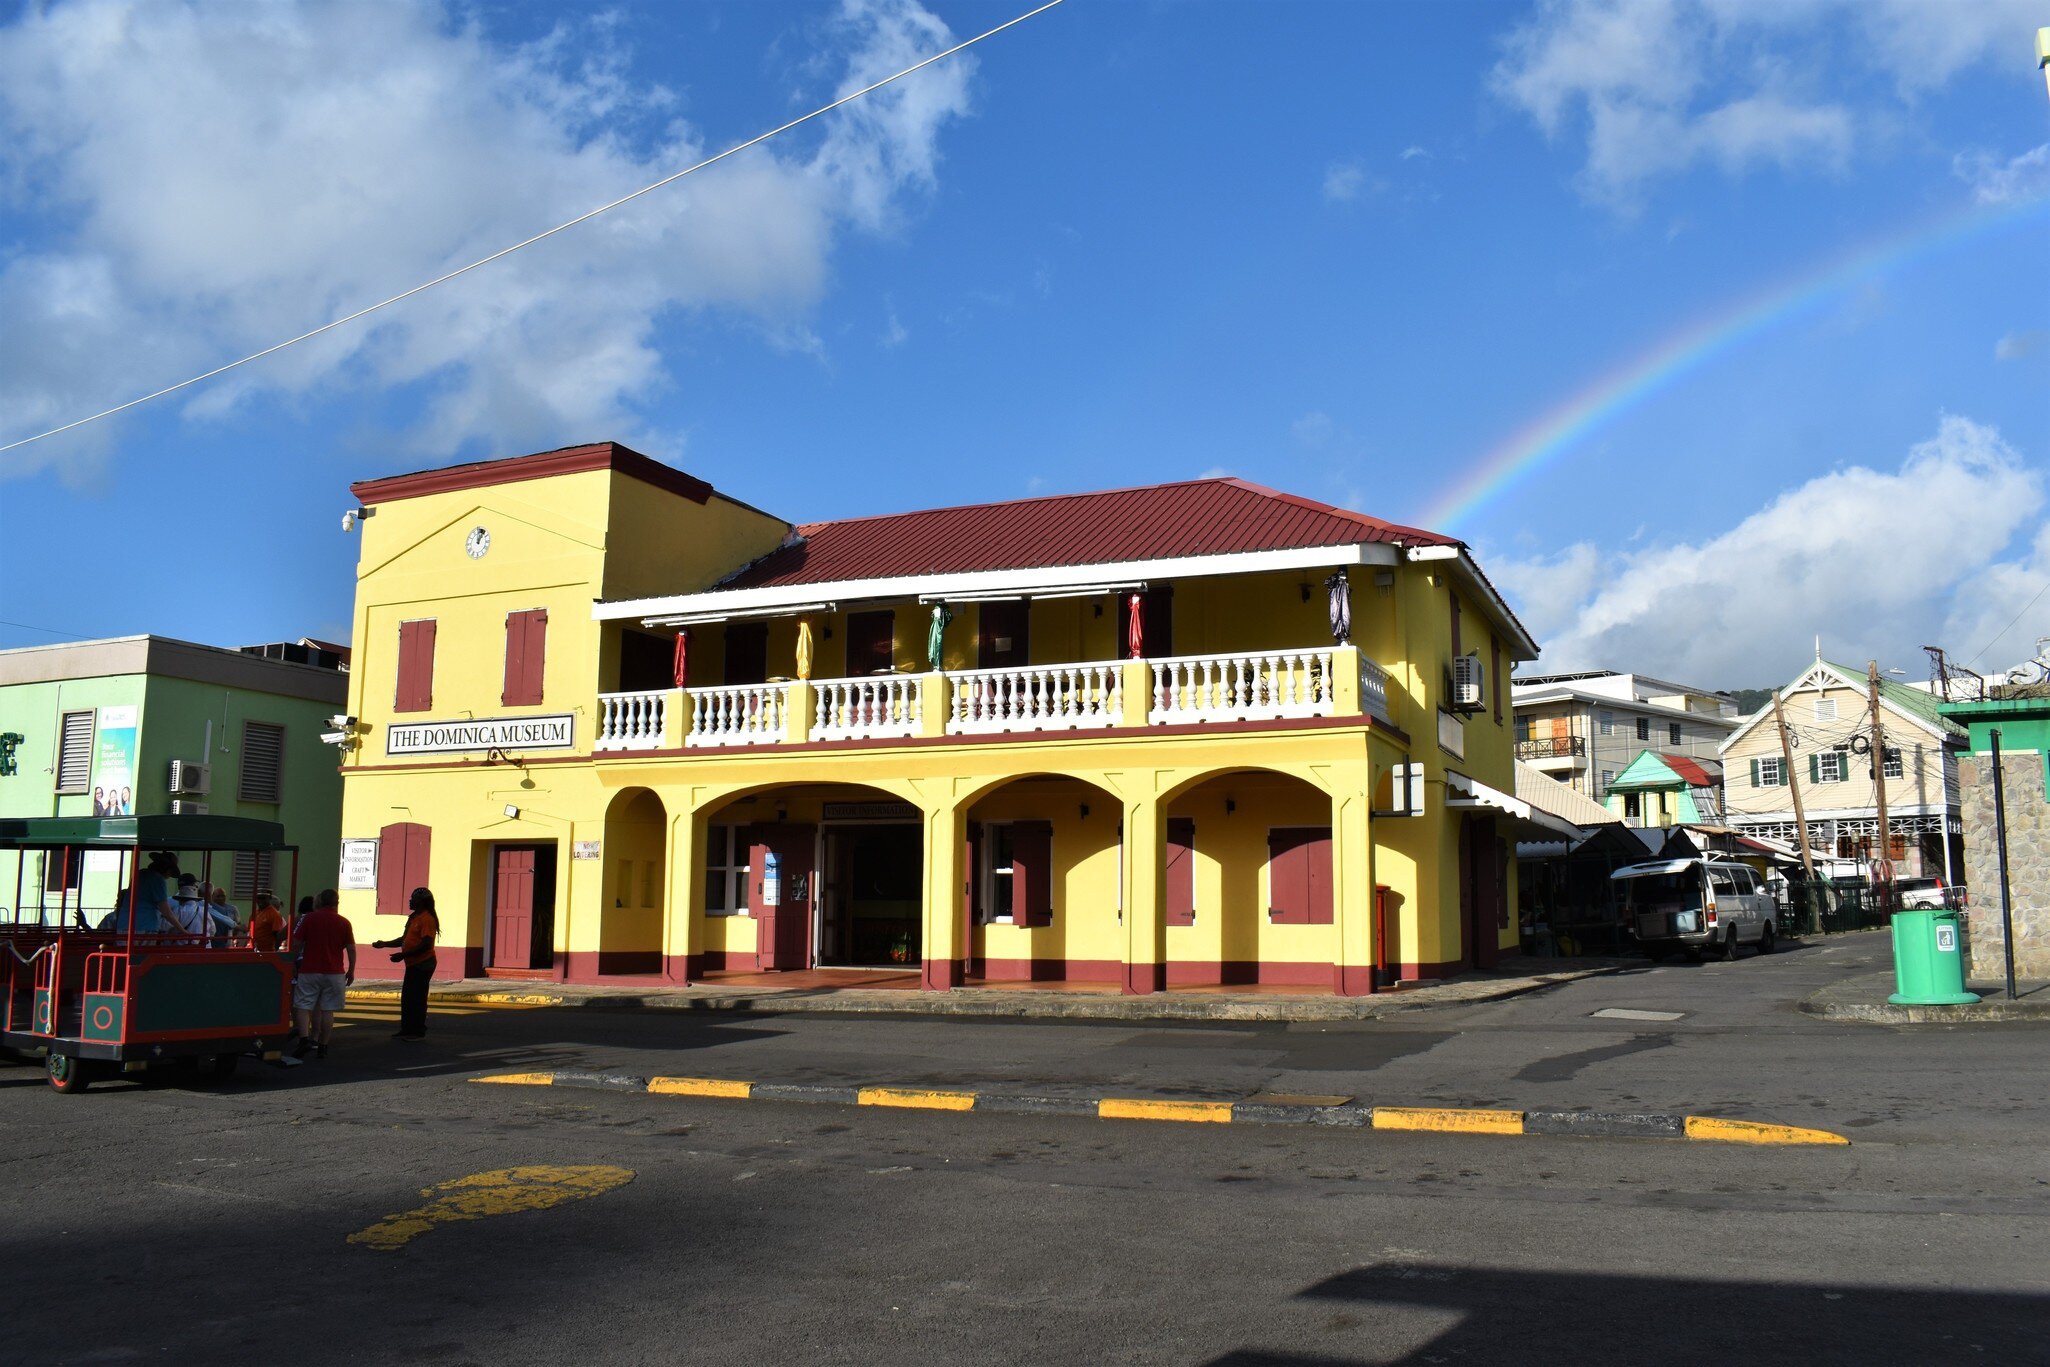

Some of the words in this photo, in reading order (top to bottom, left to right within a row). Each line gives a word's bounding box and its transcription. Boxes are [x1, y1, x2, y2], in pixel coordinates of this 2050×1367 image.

[393, 730, 420, 747] THE
[423, 726, 498, 746] DOMINICA
[500, 723, 566, 743] MUSEUM
[825, 805, 856, 817] VISITOR
[858, 804, 915, 816] INFORMATION
[349, 875, 366, 883] MARKET
